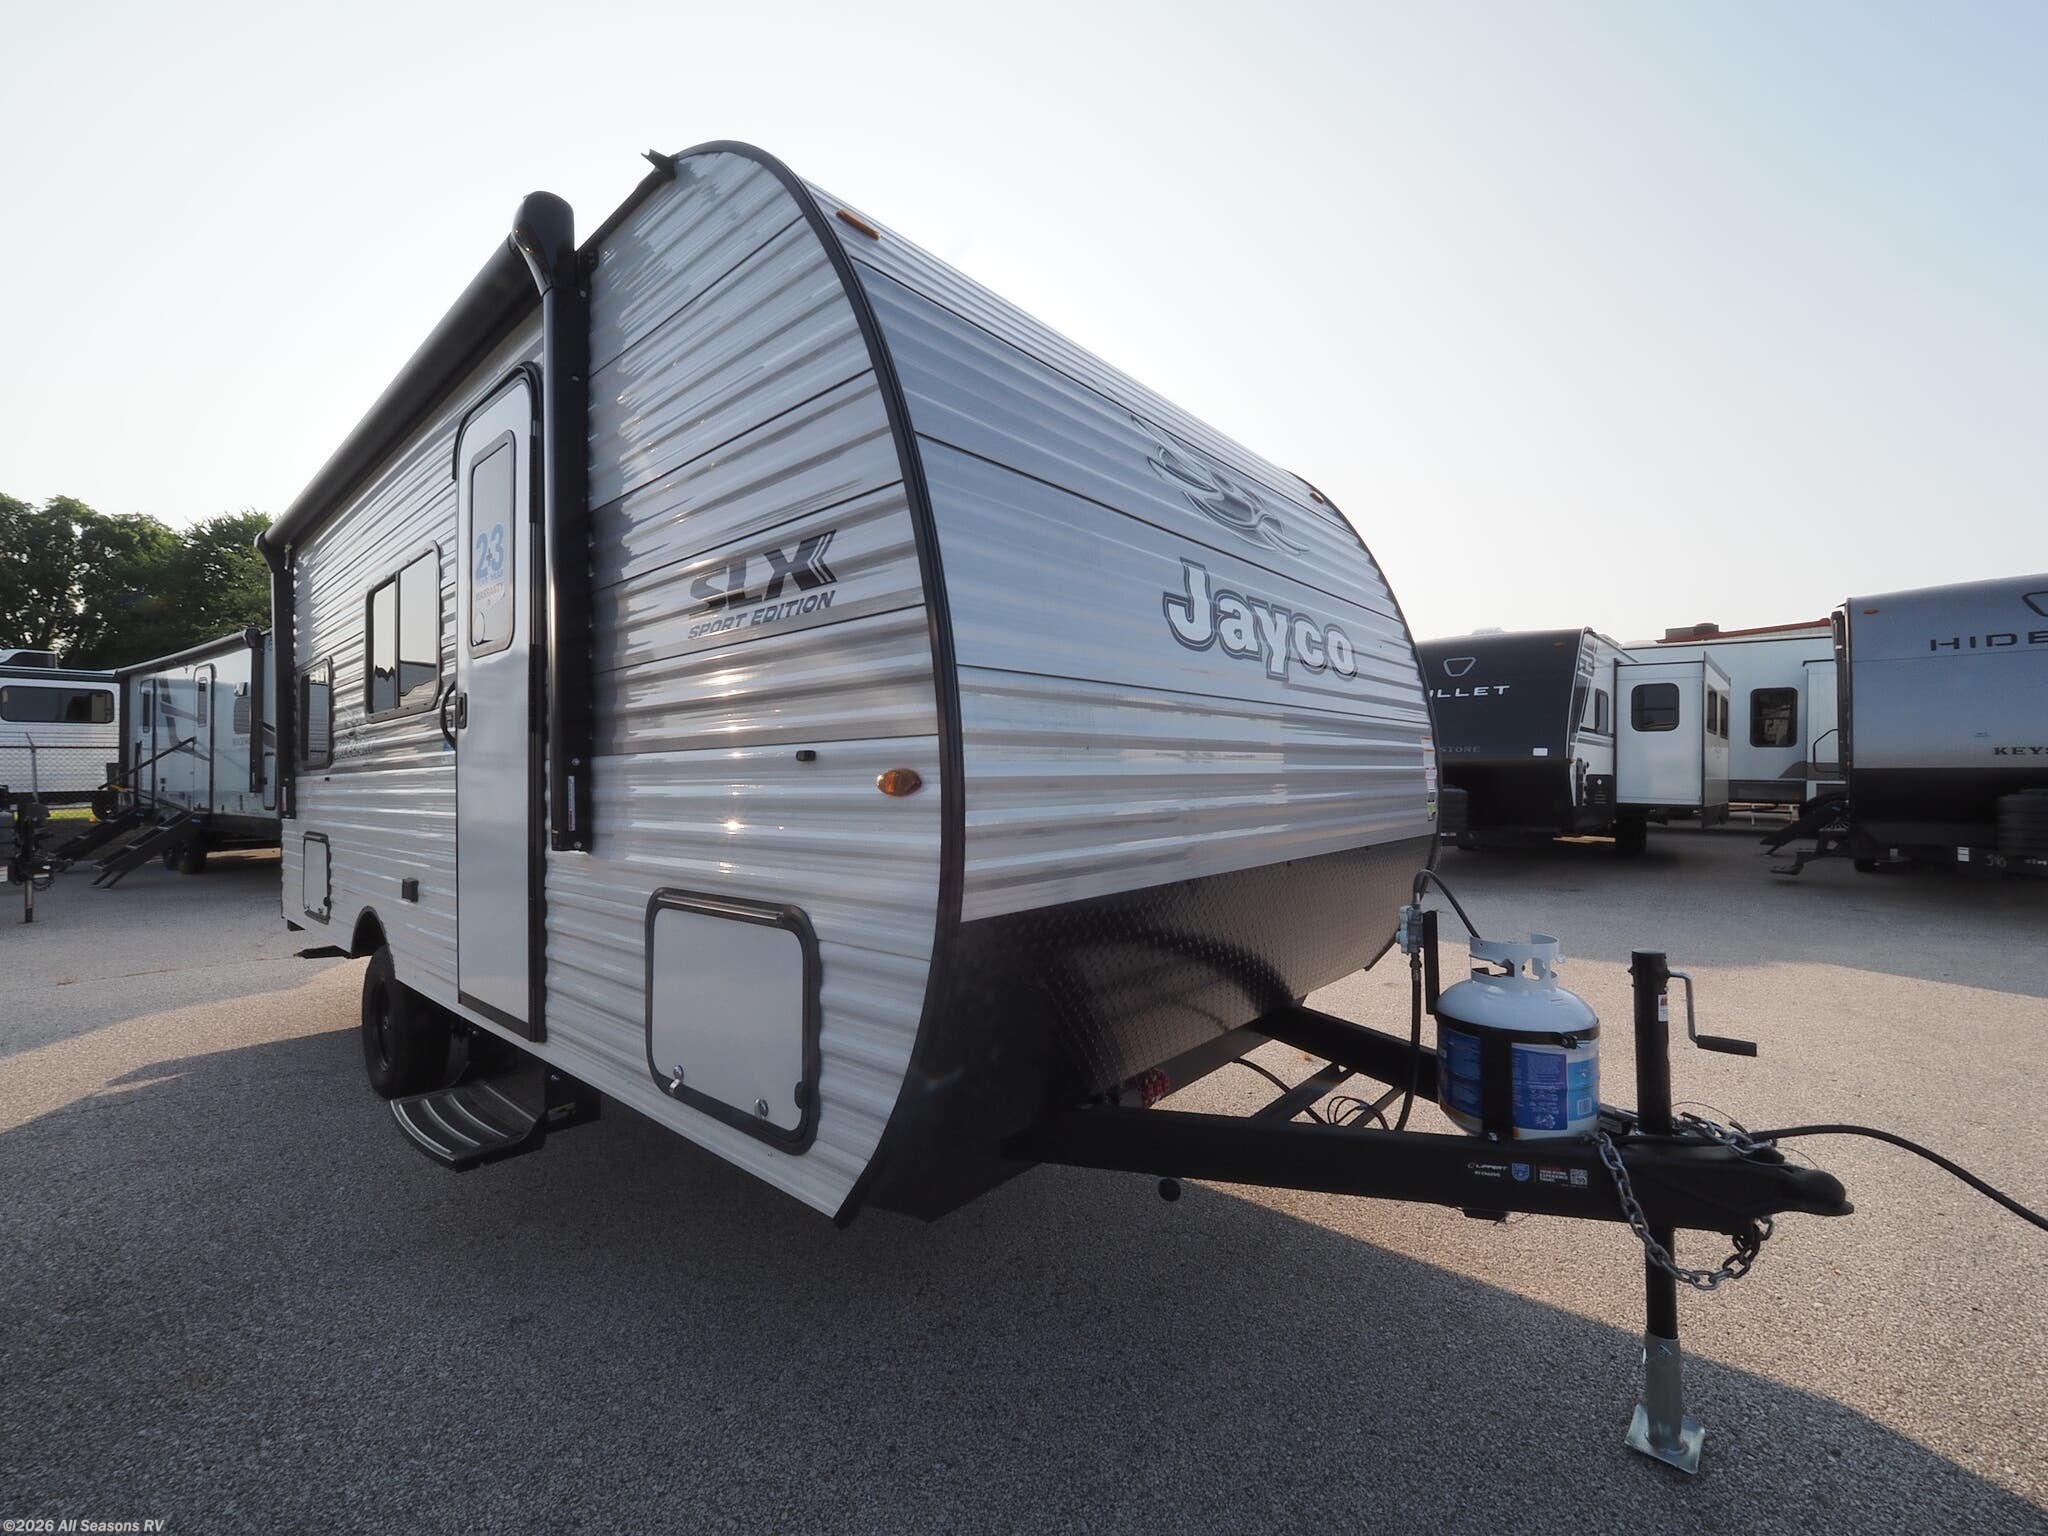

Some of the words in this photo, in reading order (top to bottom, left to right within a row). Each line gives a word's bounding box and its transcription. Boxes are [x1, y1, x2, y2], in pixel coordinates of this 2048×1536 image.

[688, 529, 838, 619] SLX
[688, 612, 748, 640] SPORT
[750, 589, 837, 626] EDITION
[1162, 556, 1358, 681] Jayco
[1993, 746, 2048, 755] KEY
